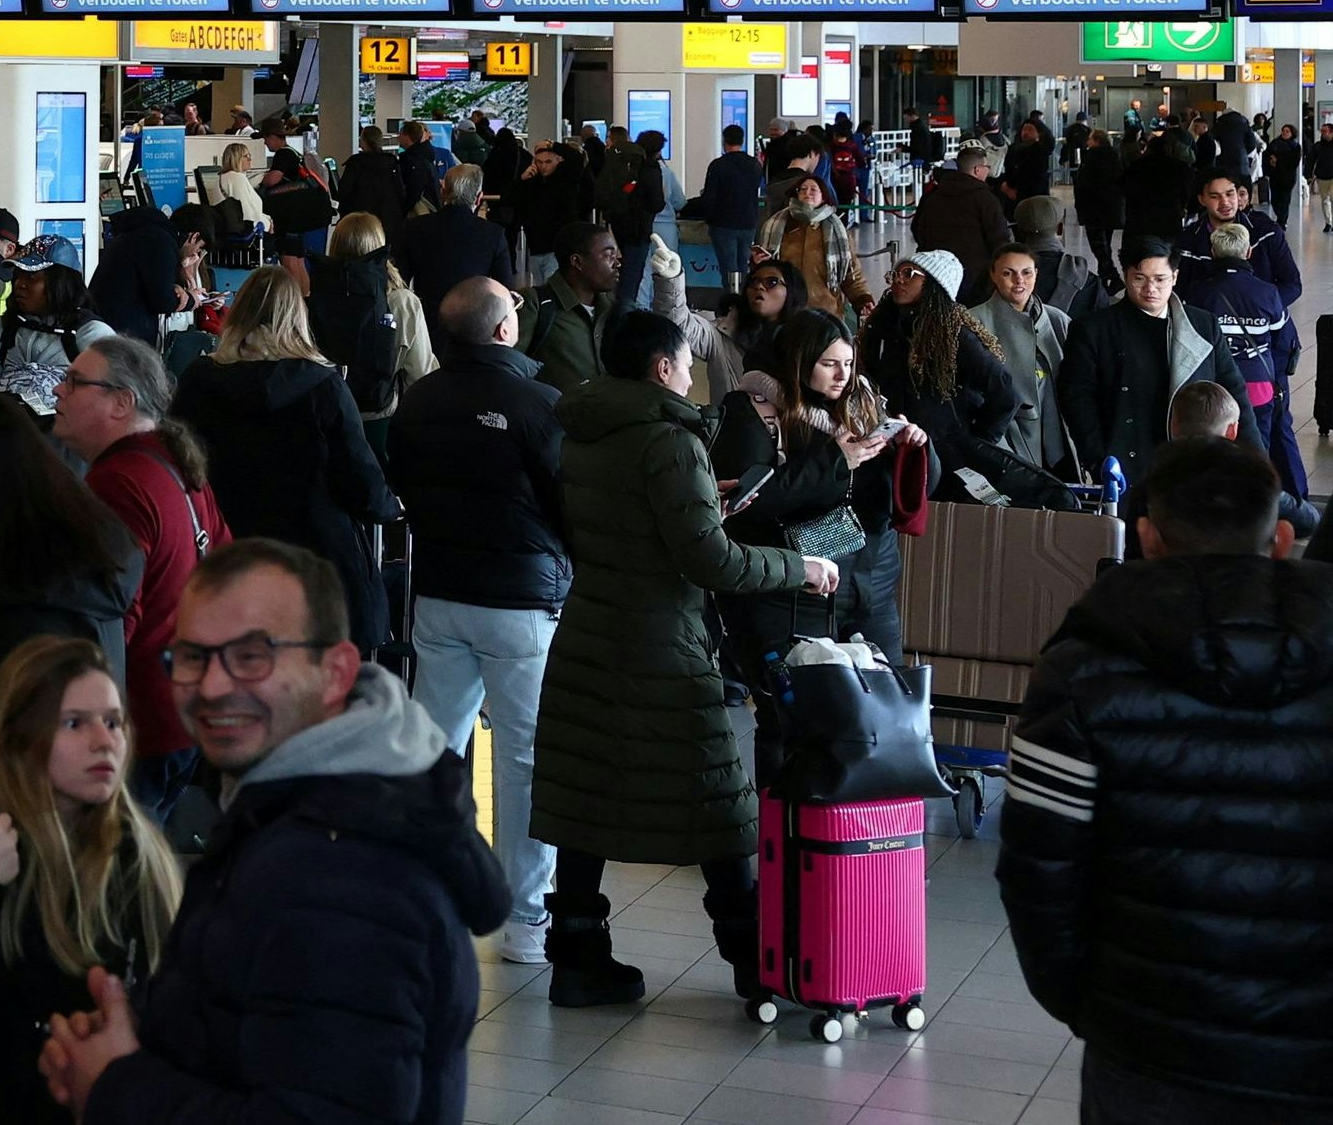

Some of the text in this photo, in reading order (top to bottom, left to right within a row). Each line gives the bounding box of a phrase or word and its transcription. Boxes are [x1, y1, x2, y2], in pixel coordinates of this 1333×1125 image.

[171, 29, 187, 42] Gates
[730, 29, 760, 43] 12-15
[371, 40, 399, 62] 12
[495, 45, 520, 65] 11
[686, 53, 716, 62] Economy
